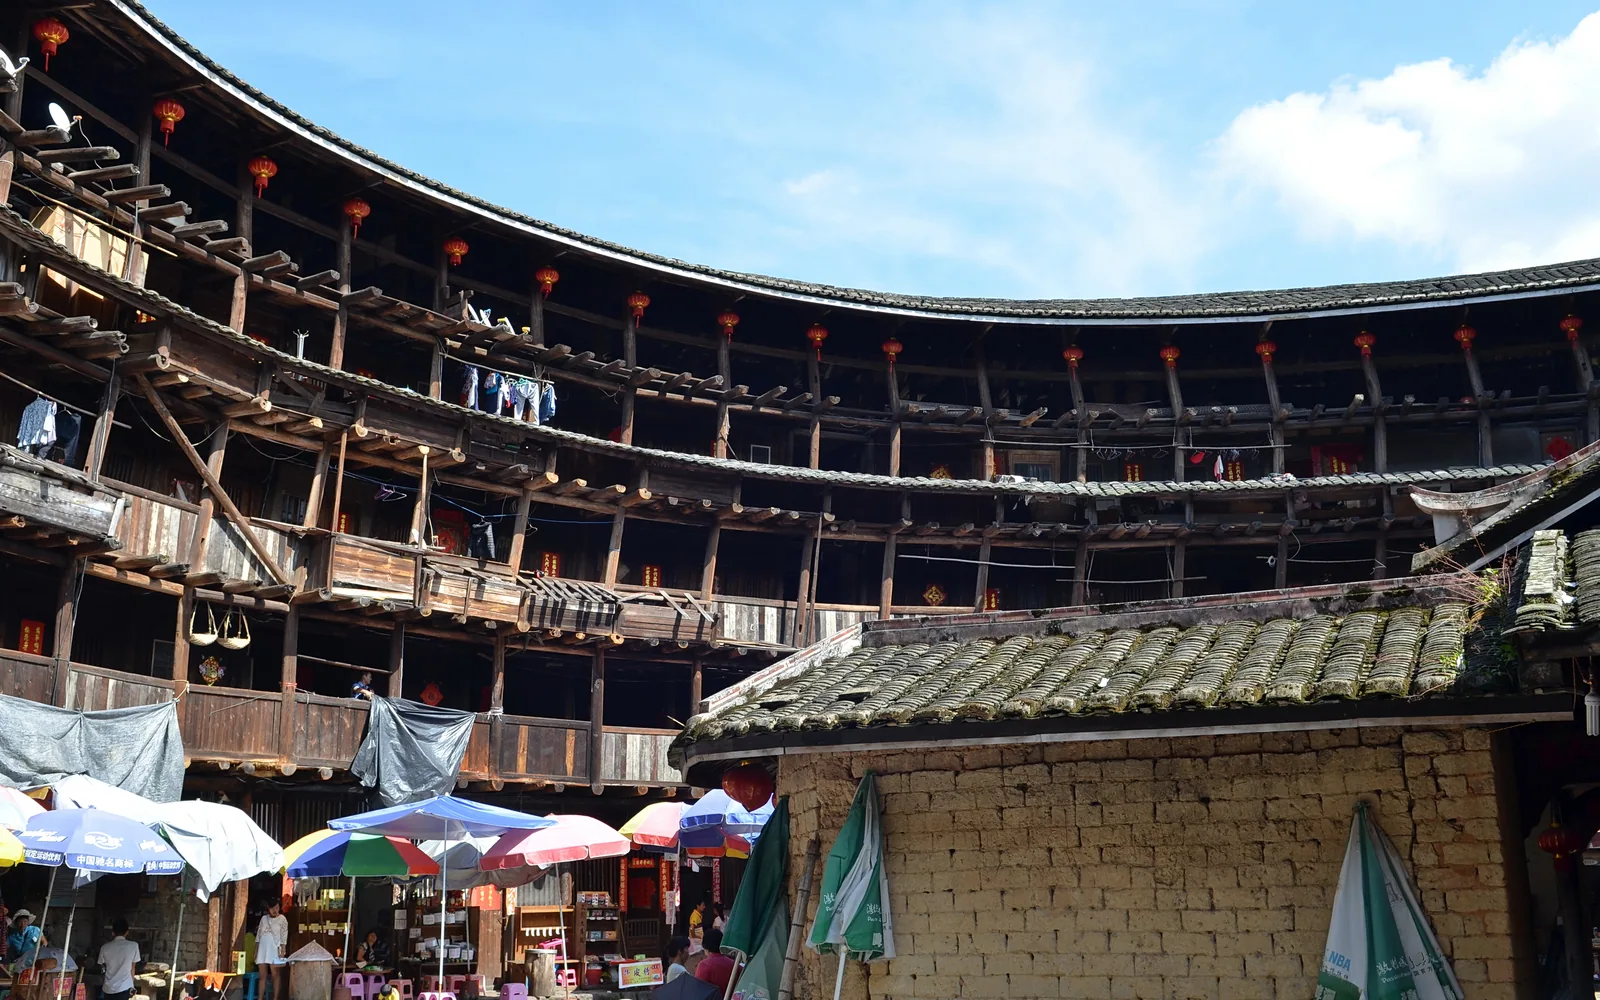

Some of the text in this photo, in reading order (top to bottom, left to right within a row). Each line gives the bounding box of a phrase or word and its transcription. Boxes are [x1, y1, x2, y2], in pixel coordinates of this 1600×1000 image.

[76, 855, 134, 869] 中国驰名商标
[1328, 951, 1351, 972] NBA
